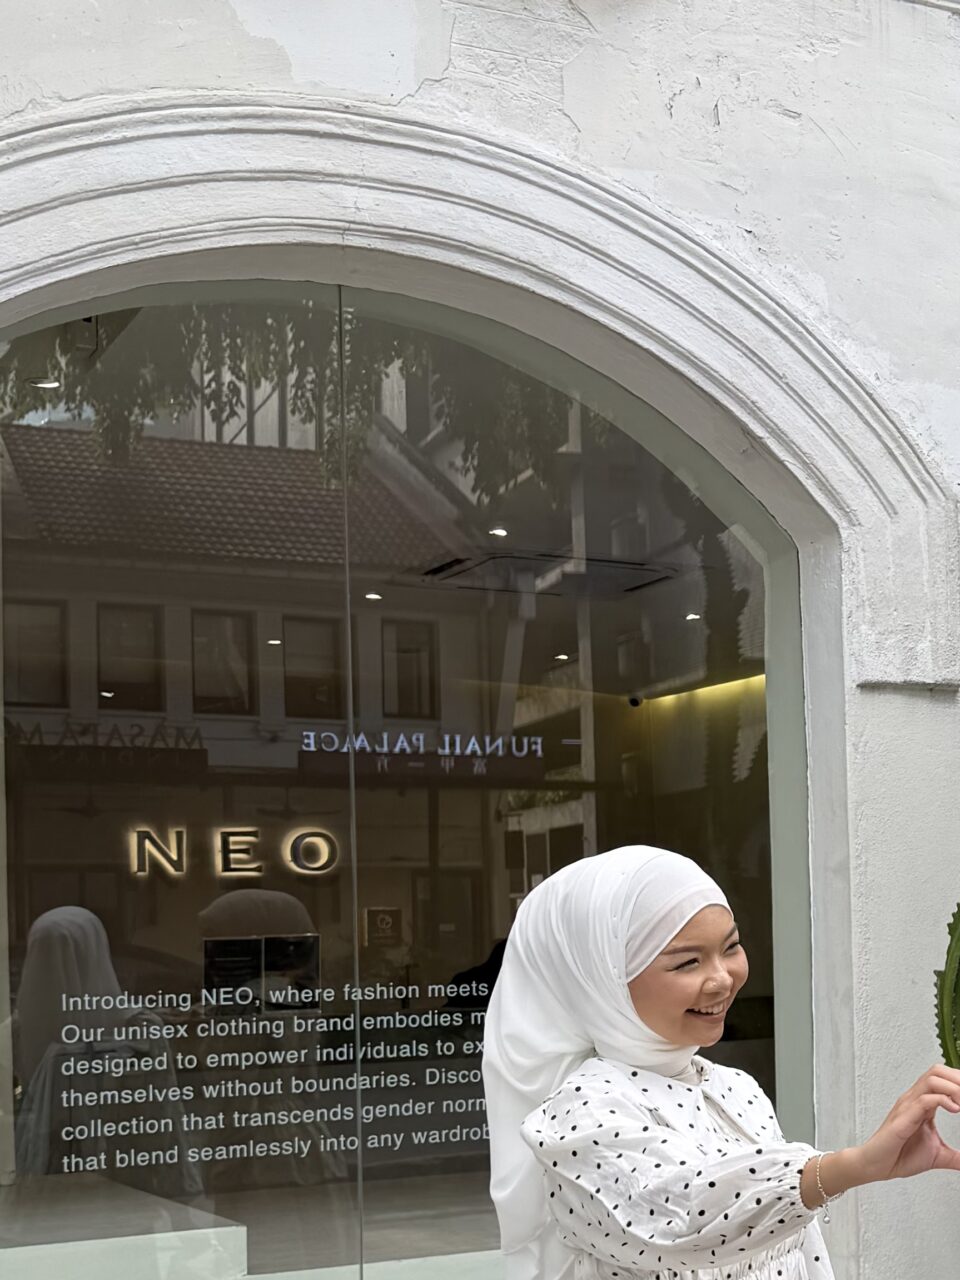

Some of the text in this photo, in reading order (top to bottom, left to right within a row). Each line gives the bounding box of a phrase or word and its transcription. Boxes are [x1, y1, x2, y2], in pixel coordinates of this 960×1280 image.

[130, 828, 340, 875] NEO
[62, 980, 489, 1012] Introducing NEO, where fashion meets
[61, 1025, 105, 1044] Our
[113, 1021, 188, 1041] unisex
[197, 1017, 284, 1039] clothing
[293, 1013, 355, 1033] brand
[363, 1010, 463, 1030] embodies
[61, 1053, 167, 1077] designed
[176, 1053, 198, 1069] to
[206, 1048, 308, 1070] empower
[316, 1040, 429, 1062] individuals
[436, 1040, 455, 1056] to
[61, 1068, 481, 1108] themselves without boundaries. Disco
[61, 1116, 173, 1141] collection
[181, 1112, 225, 1131] that
[233, 1104, 354, 1128] transcends
[362, 1099, 436, 1123] gender
[61, 1124, 490, 1173] that blend seamlessly into any wardrob
